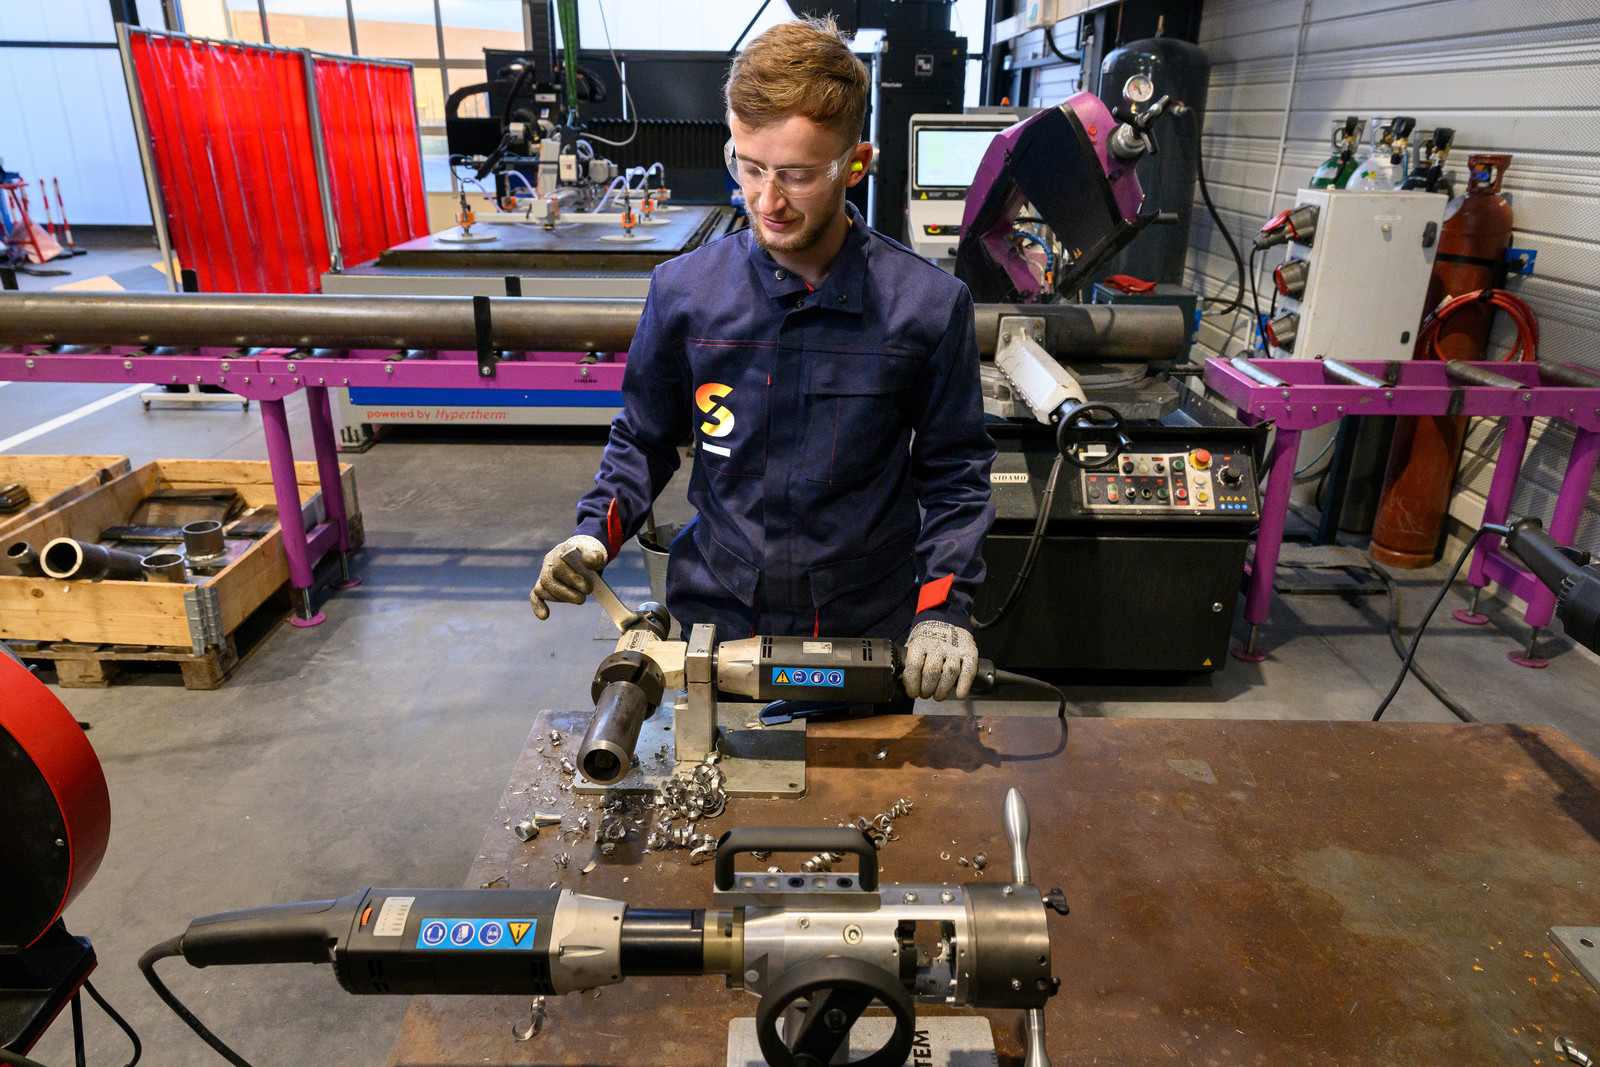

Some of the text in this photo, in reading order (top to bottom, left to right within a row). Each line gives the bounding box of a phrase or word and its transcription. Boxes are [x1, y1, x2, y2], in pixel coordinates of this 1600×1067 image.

[367, 408, 506, 421] powered by Hypertherm
